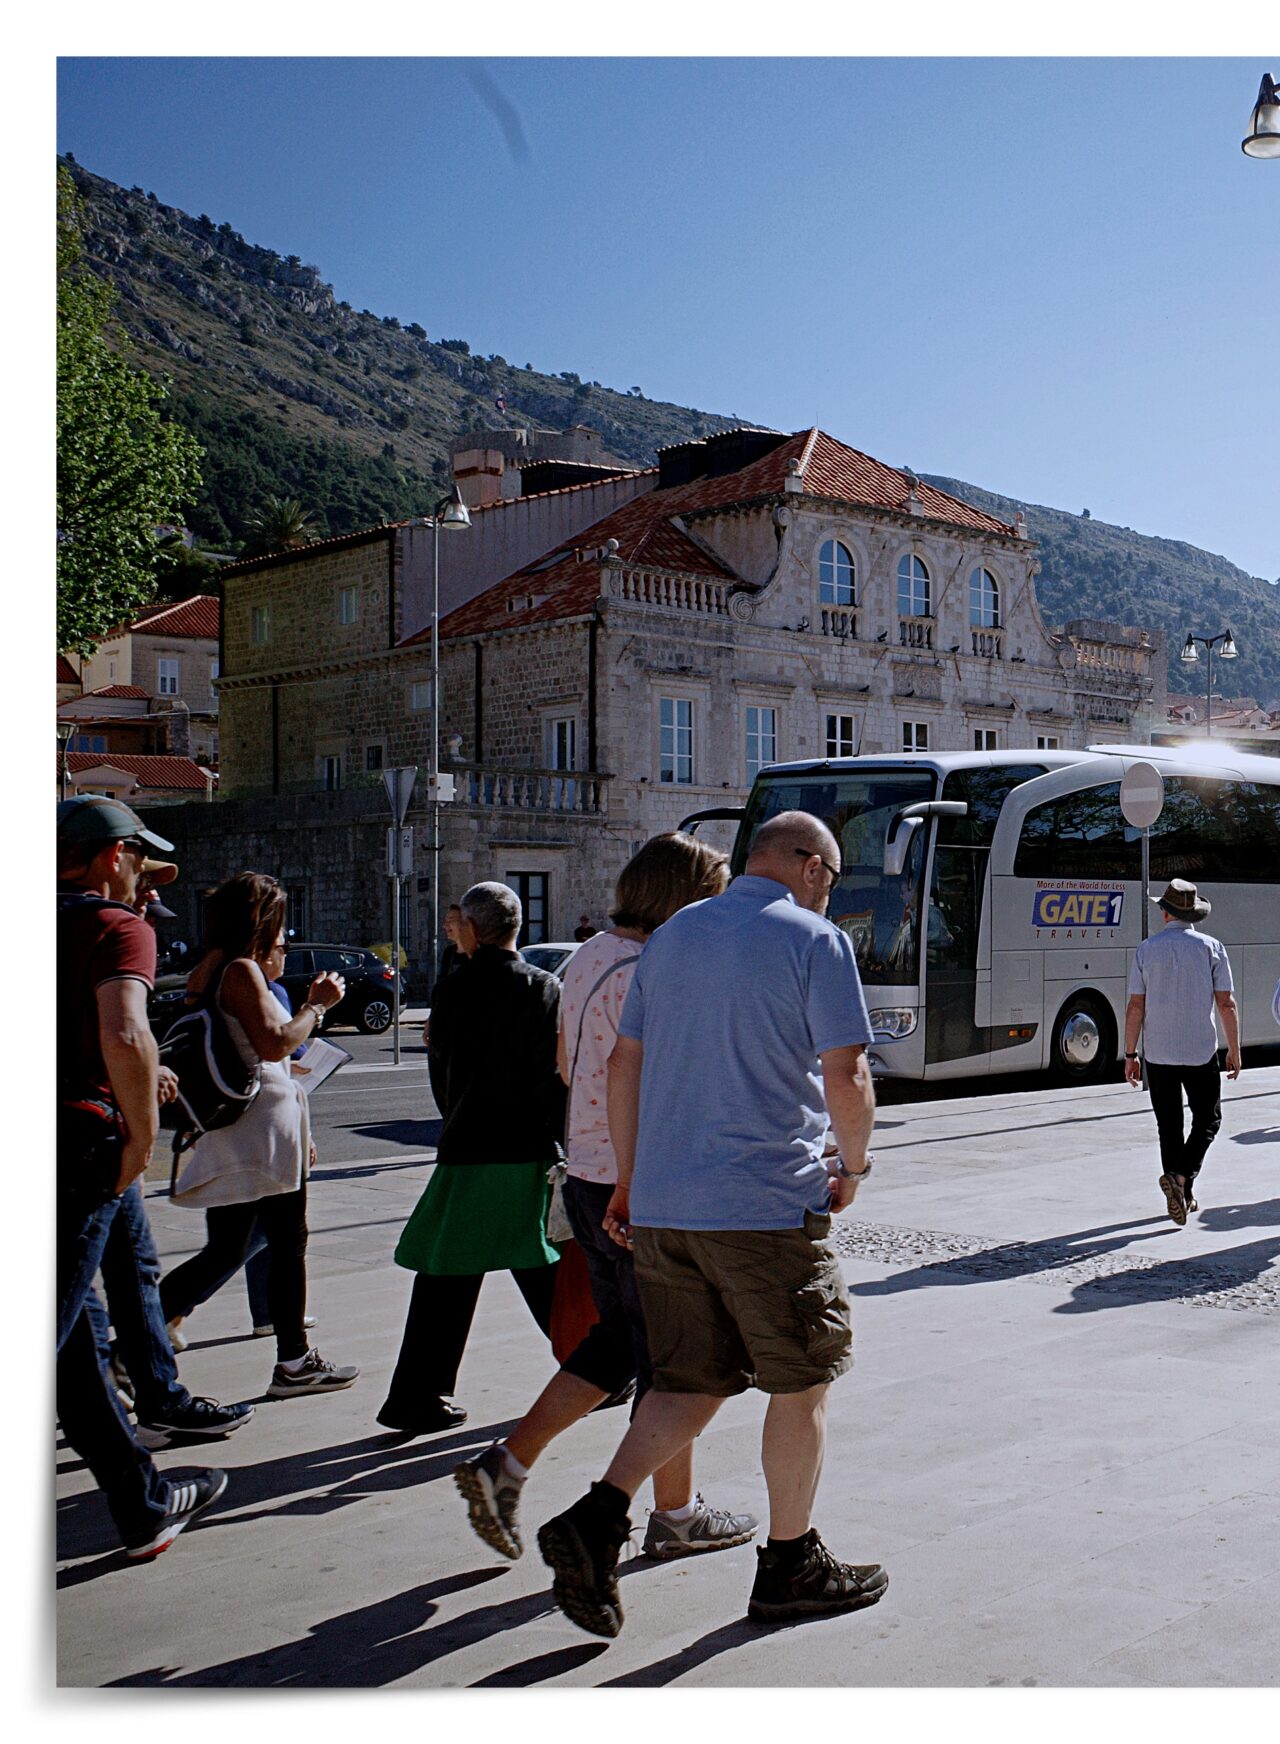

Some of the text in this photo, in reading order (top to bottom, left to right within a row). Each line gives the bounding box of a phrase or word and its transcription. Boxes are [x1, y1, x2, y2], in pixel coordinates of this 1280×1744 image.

[1056, 881, 1065, 889] of
[1066, 881, 1078, 889] the
[1079, 881, 1099, 890] World
[1100, 881, 1111, 890] for
[1112, 882, 1126, 891] Less
[1037, 929, 1114, 938] TRAVEL
